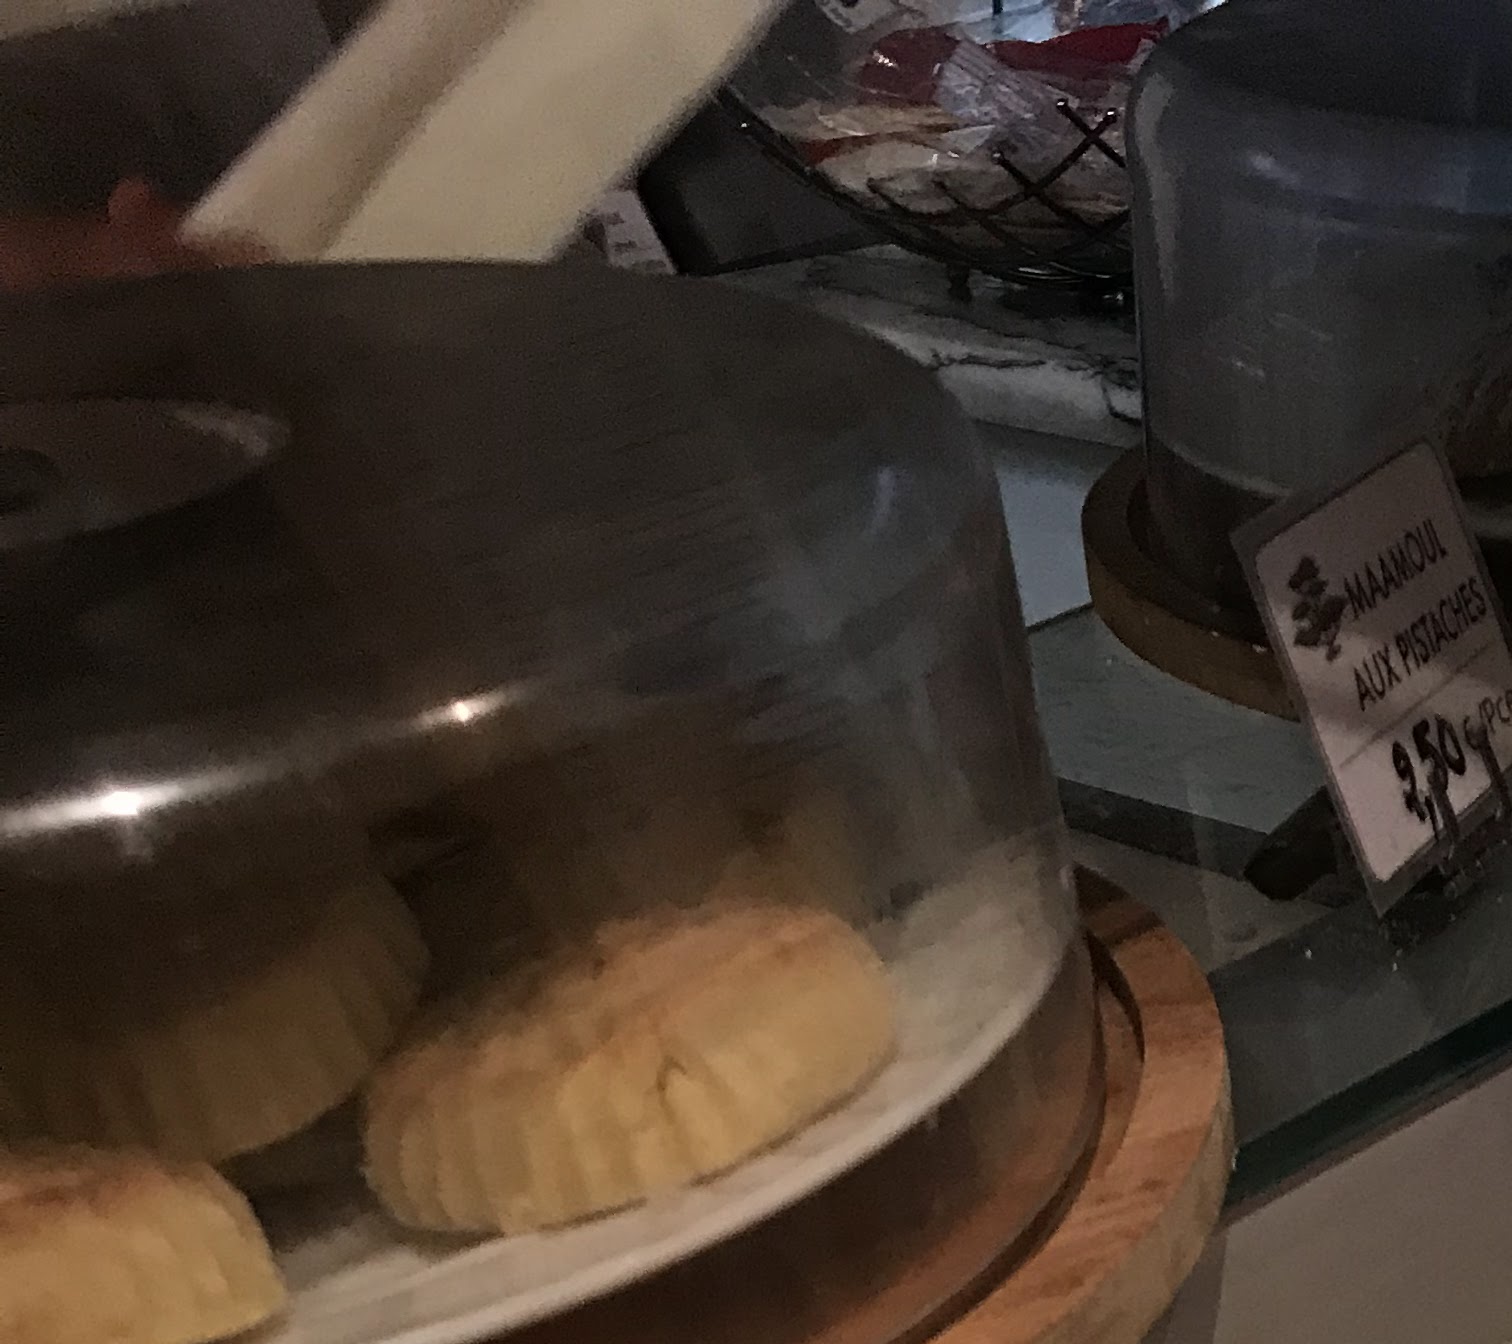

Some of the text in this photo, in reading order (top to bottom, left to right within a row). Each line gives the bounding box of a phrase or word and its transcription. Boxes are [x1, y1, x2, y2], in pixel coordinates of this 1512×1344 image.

[1342, 518, 1448, 619] MAAMOUL
[1352, 576, 1489, 712] AUX PISTACHES
